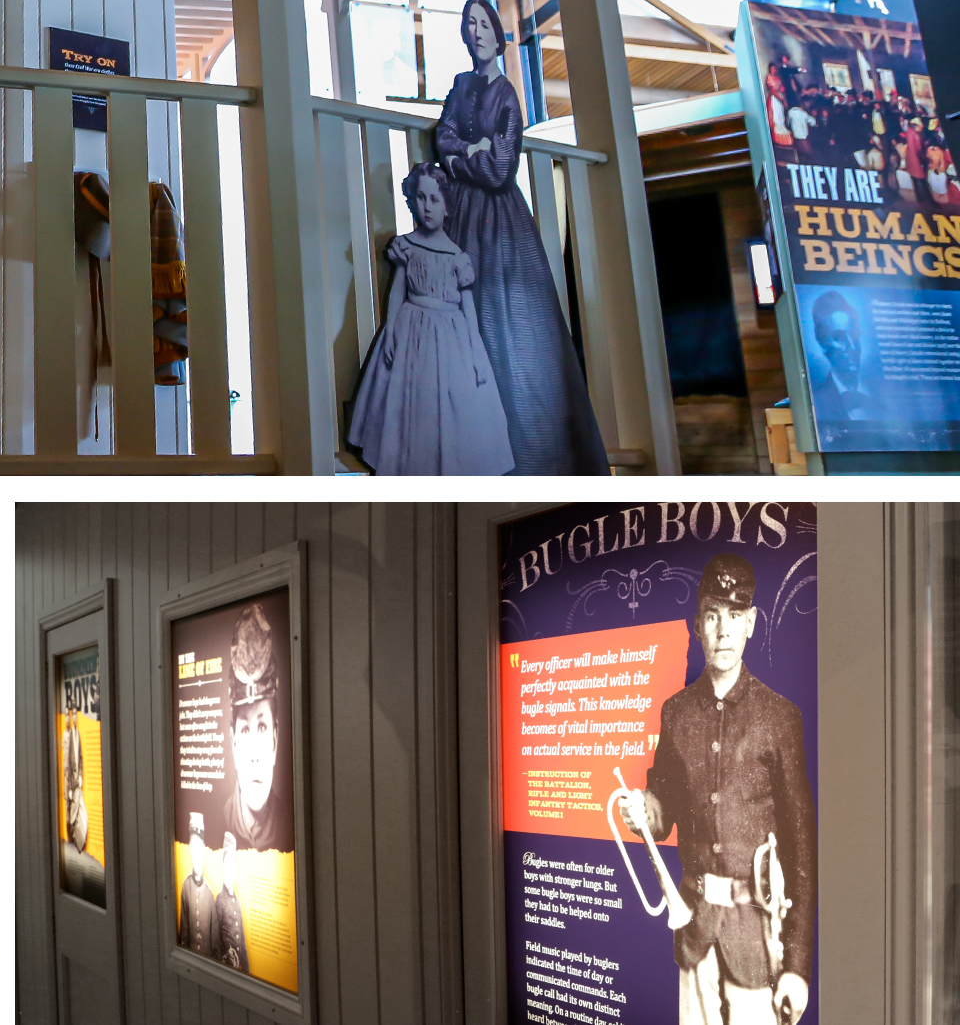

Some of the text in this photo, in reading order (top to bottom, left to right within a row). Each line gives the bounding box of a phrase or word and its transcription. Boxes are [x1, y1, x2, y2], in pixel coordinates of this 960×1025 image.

[62, 49, 116, 68] TRY ON
[786, 164, 884, 203] THEY ARE
[794, 205, 960, 243] HUMAN
[800, 239, 960, 279] BEINGS
[518, 502, 789, 592] BUGLE BOYS
[179, 657, 222, 679] LINE OF FIRE
[545, 656, 572, 674] officer
[574, 653, 591, 667] will
[592, 650, 618, 665] make
[620, 645, 658, 664] himself
[65, 675, 98, 713] BOYS
[521, 670, 650, 697] perfectly acquainted with the
[521, 694, 651, 717] bugle signals. This knowledge
[522, 720, 644, 737] becomes of vital importance
[522, 741, 645, 759] on actual service in the field.
[544, 781, 591, 789] BATTALION,
[528, 800, 603, 811] INFANTRY TACTICS,
[528, 810, 559, 818] VOLUME
[523, 852, 614, 876] Bugles were often for older
[524, 870, 617, 892] boys with stronger lungs. But
[524, 886, 622, 909] some bugle boys were so small
